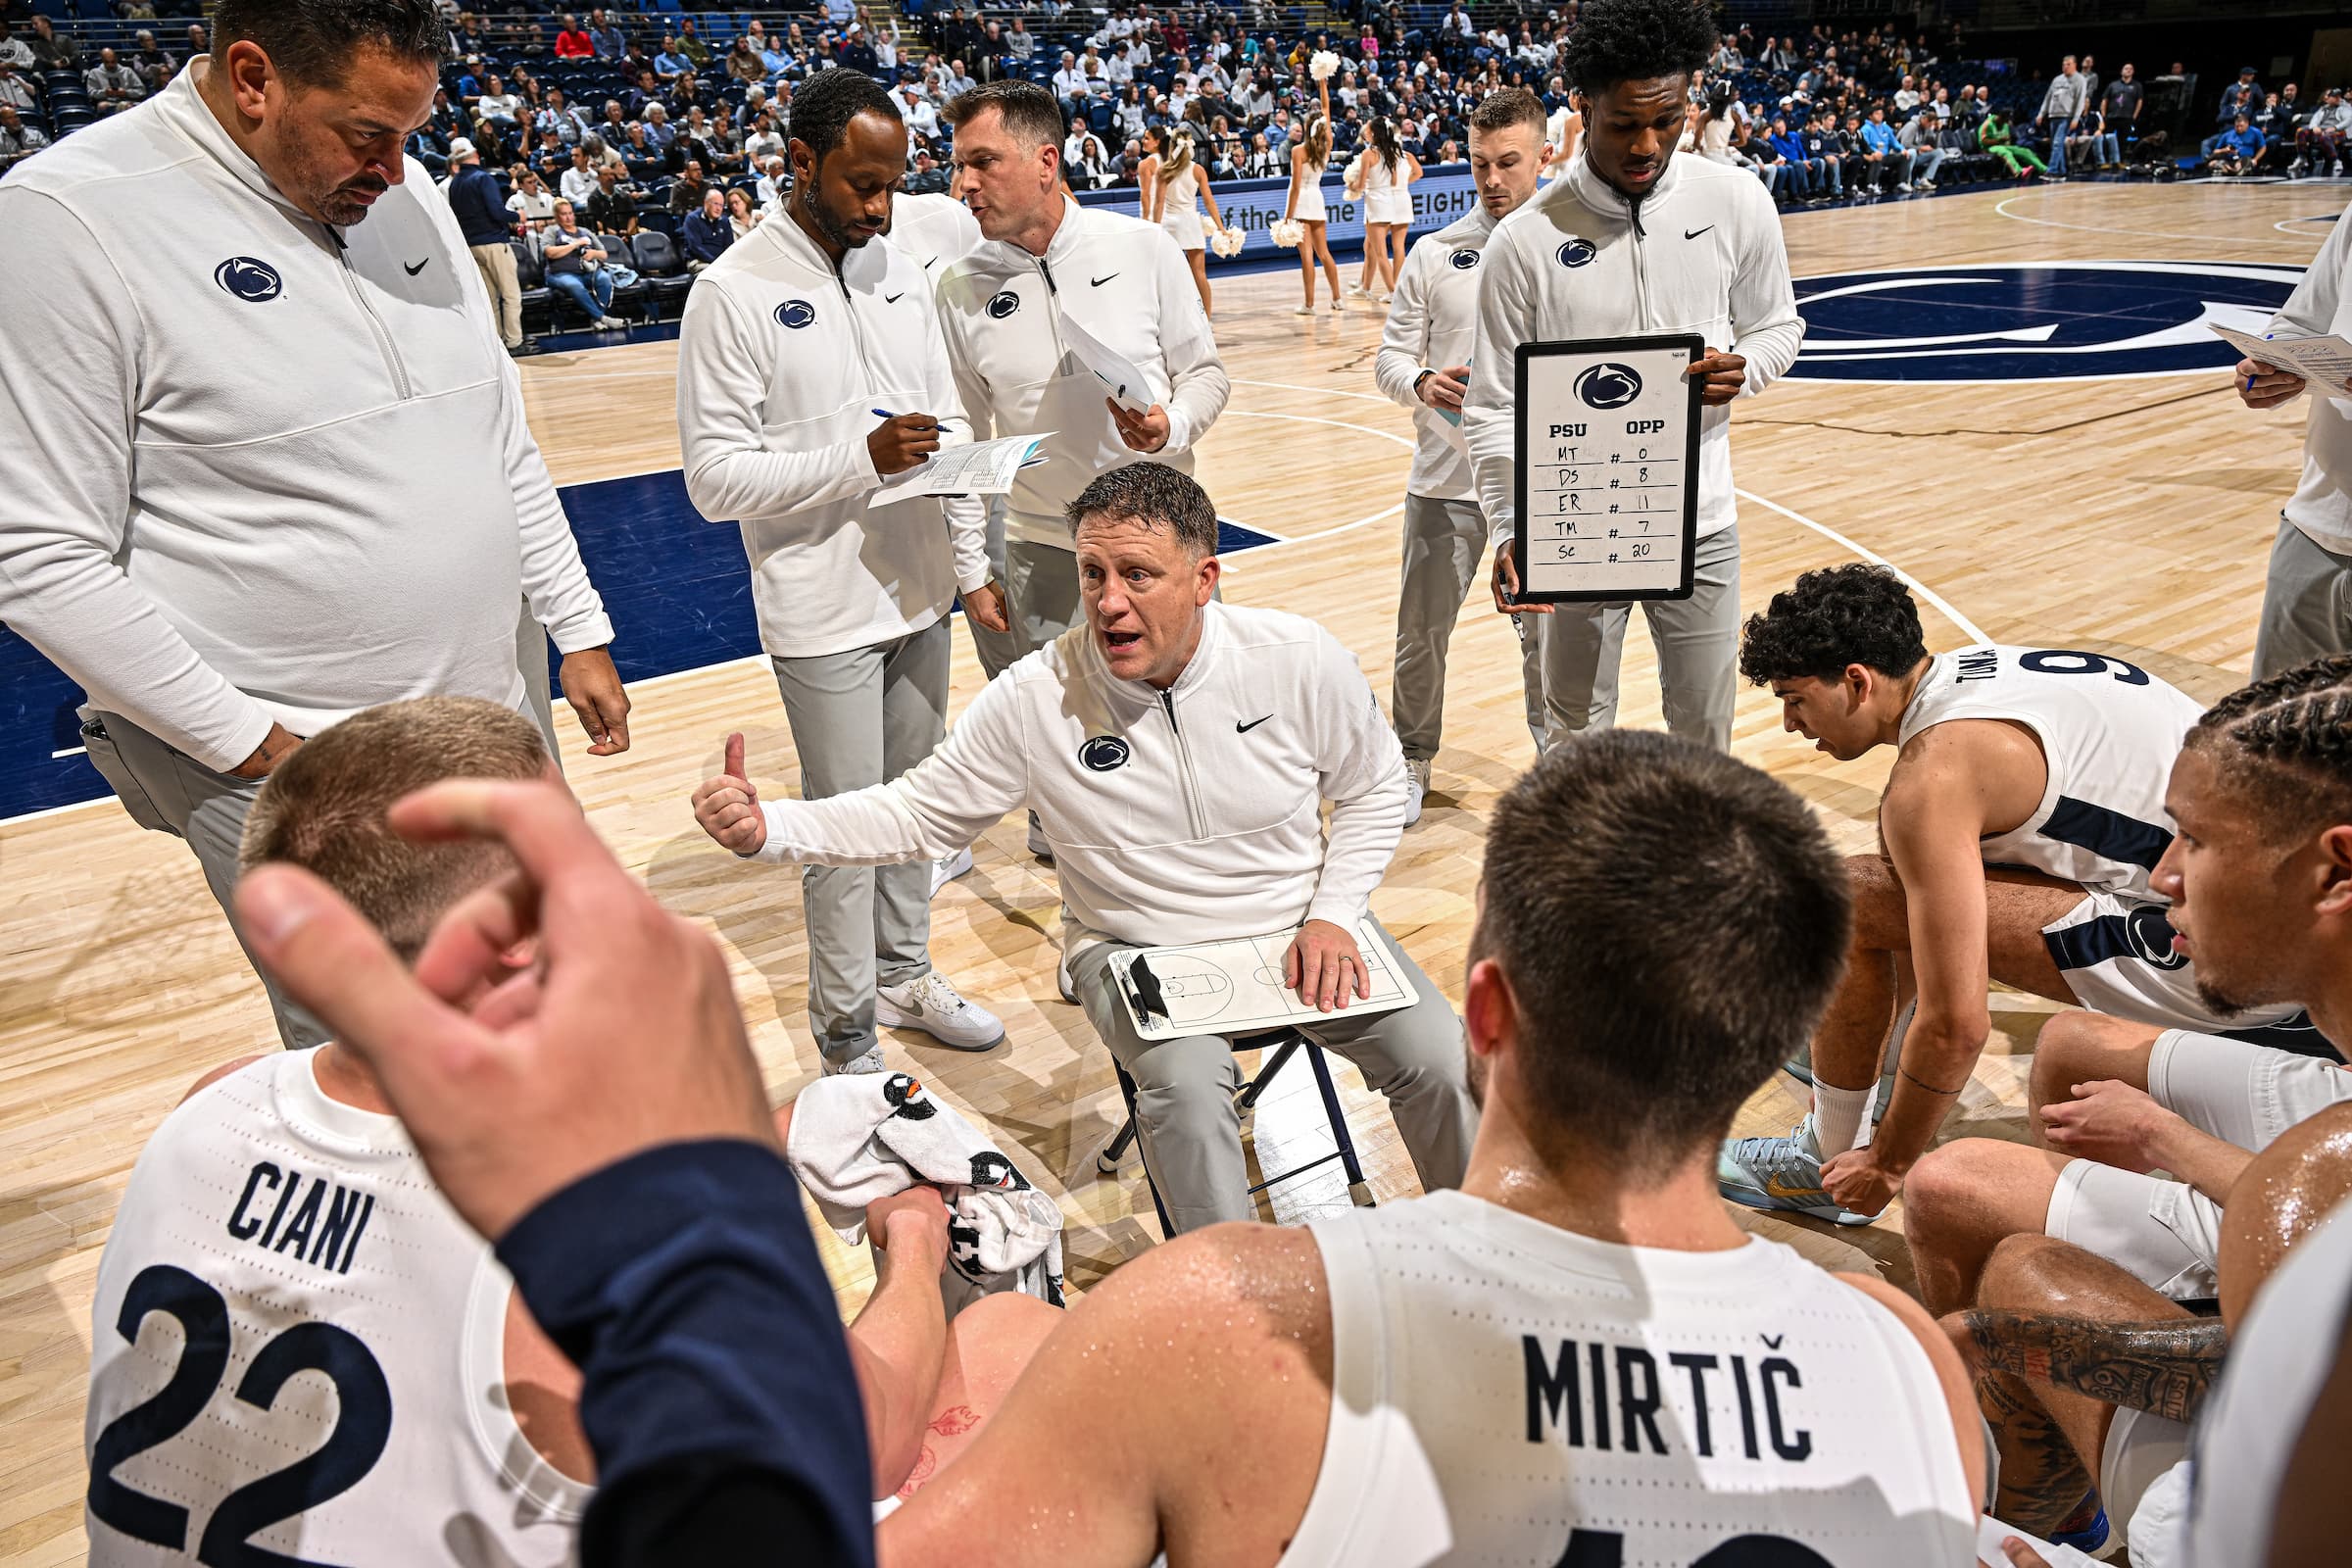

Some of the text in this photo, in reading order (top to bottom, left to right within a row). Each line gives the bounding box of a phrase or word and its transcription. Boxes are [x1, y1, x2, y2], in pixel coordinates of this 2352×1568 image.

[1240, 205, 1279, 231] the
[1549, 419, 1665, 438] PSU OPP
[1558, 447, 1579, 462] MT
[1610, 453, 1620, 465] #
[1559, 467, 1648, 490] DS # 8
[1559, 493, 1648, 514] ER # 11
[1555, 520, 1649, 540] TM # 7
[1608, 553, 1618, 564] #
[1632, 543, 1650, 558] 20
[2019, 650, 2150, 686] 9
[226, 1160, 376, 1276] CIANI
[1522, 1333, 1812, 1462] MIRTIČ
[87, 1264, 393, 1568] 22
